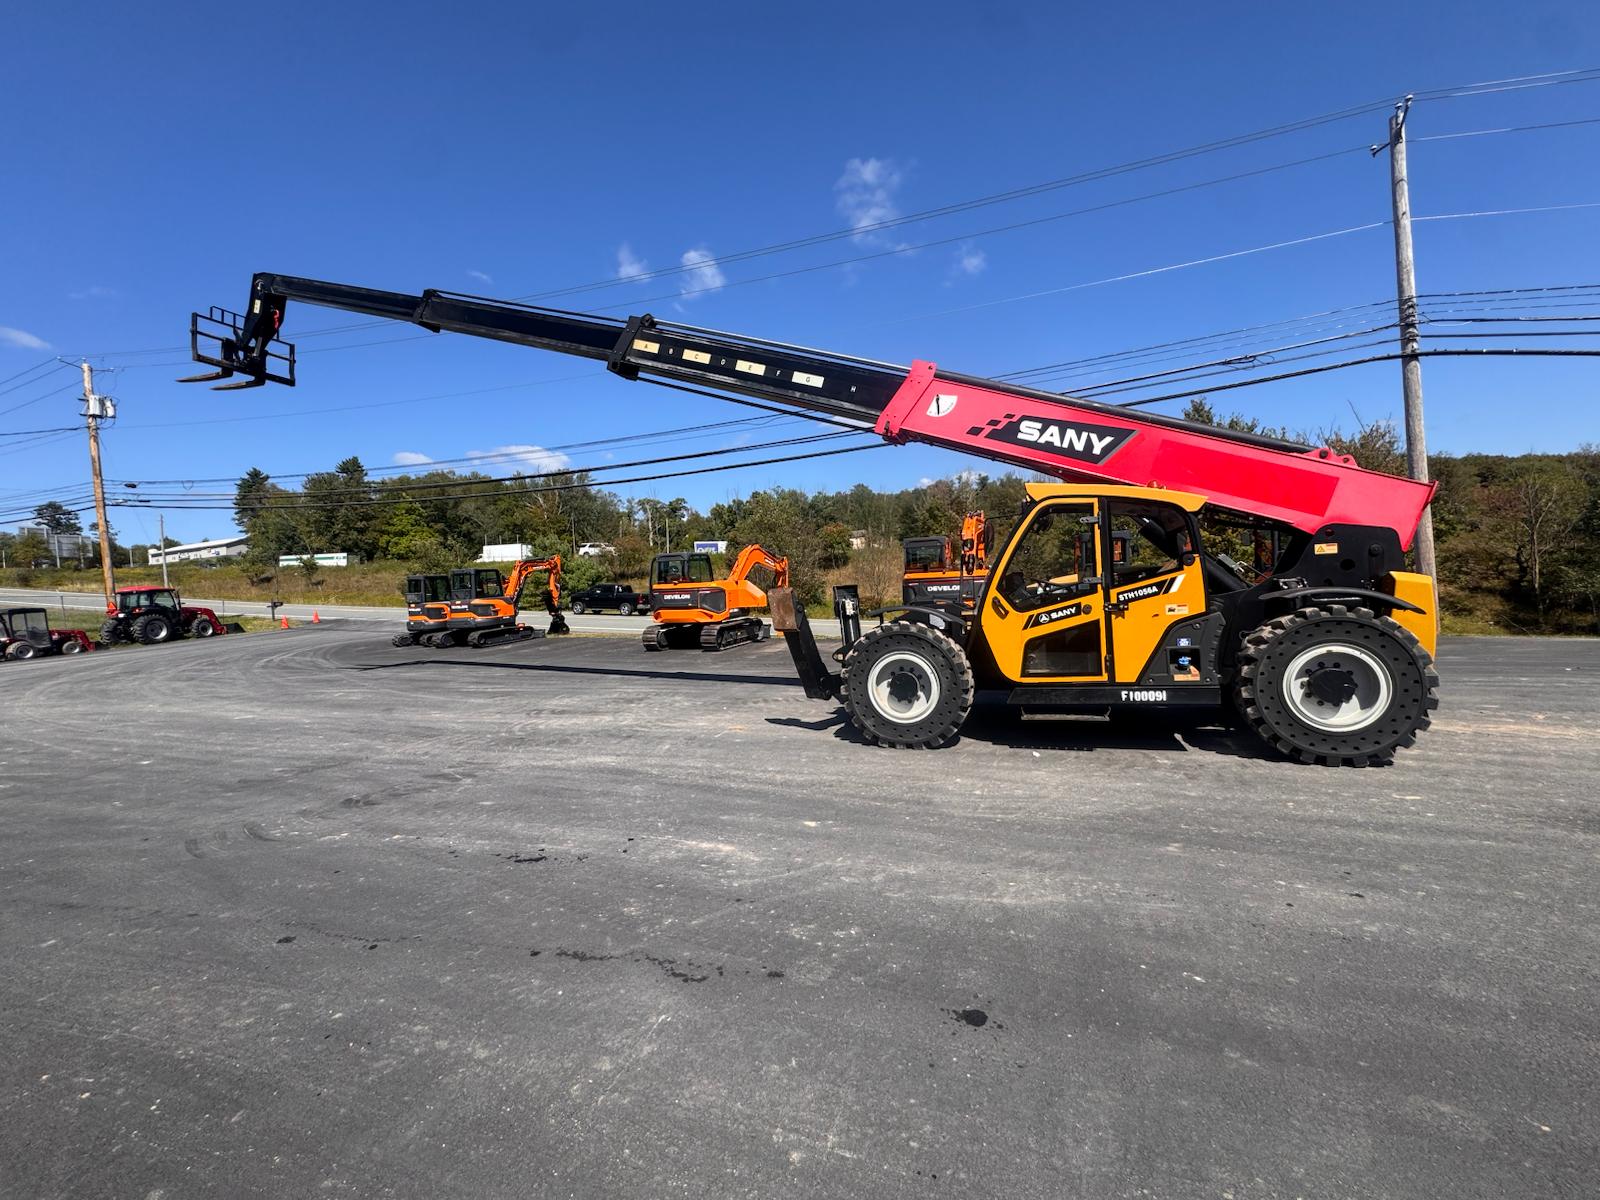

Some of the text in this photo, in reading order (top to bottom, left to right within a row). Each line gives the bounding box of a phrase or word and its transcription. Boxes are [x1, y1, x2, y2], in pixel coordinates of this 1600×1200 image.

[1016, 420, 1114, 456] SANY
[1118, 585, 1159, 601] STH1056A
[1050, 606, 1077, 620] SANY
